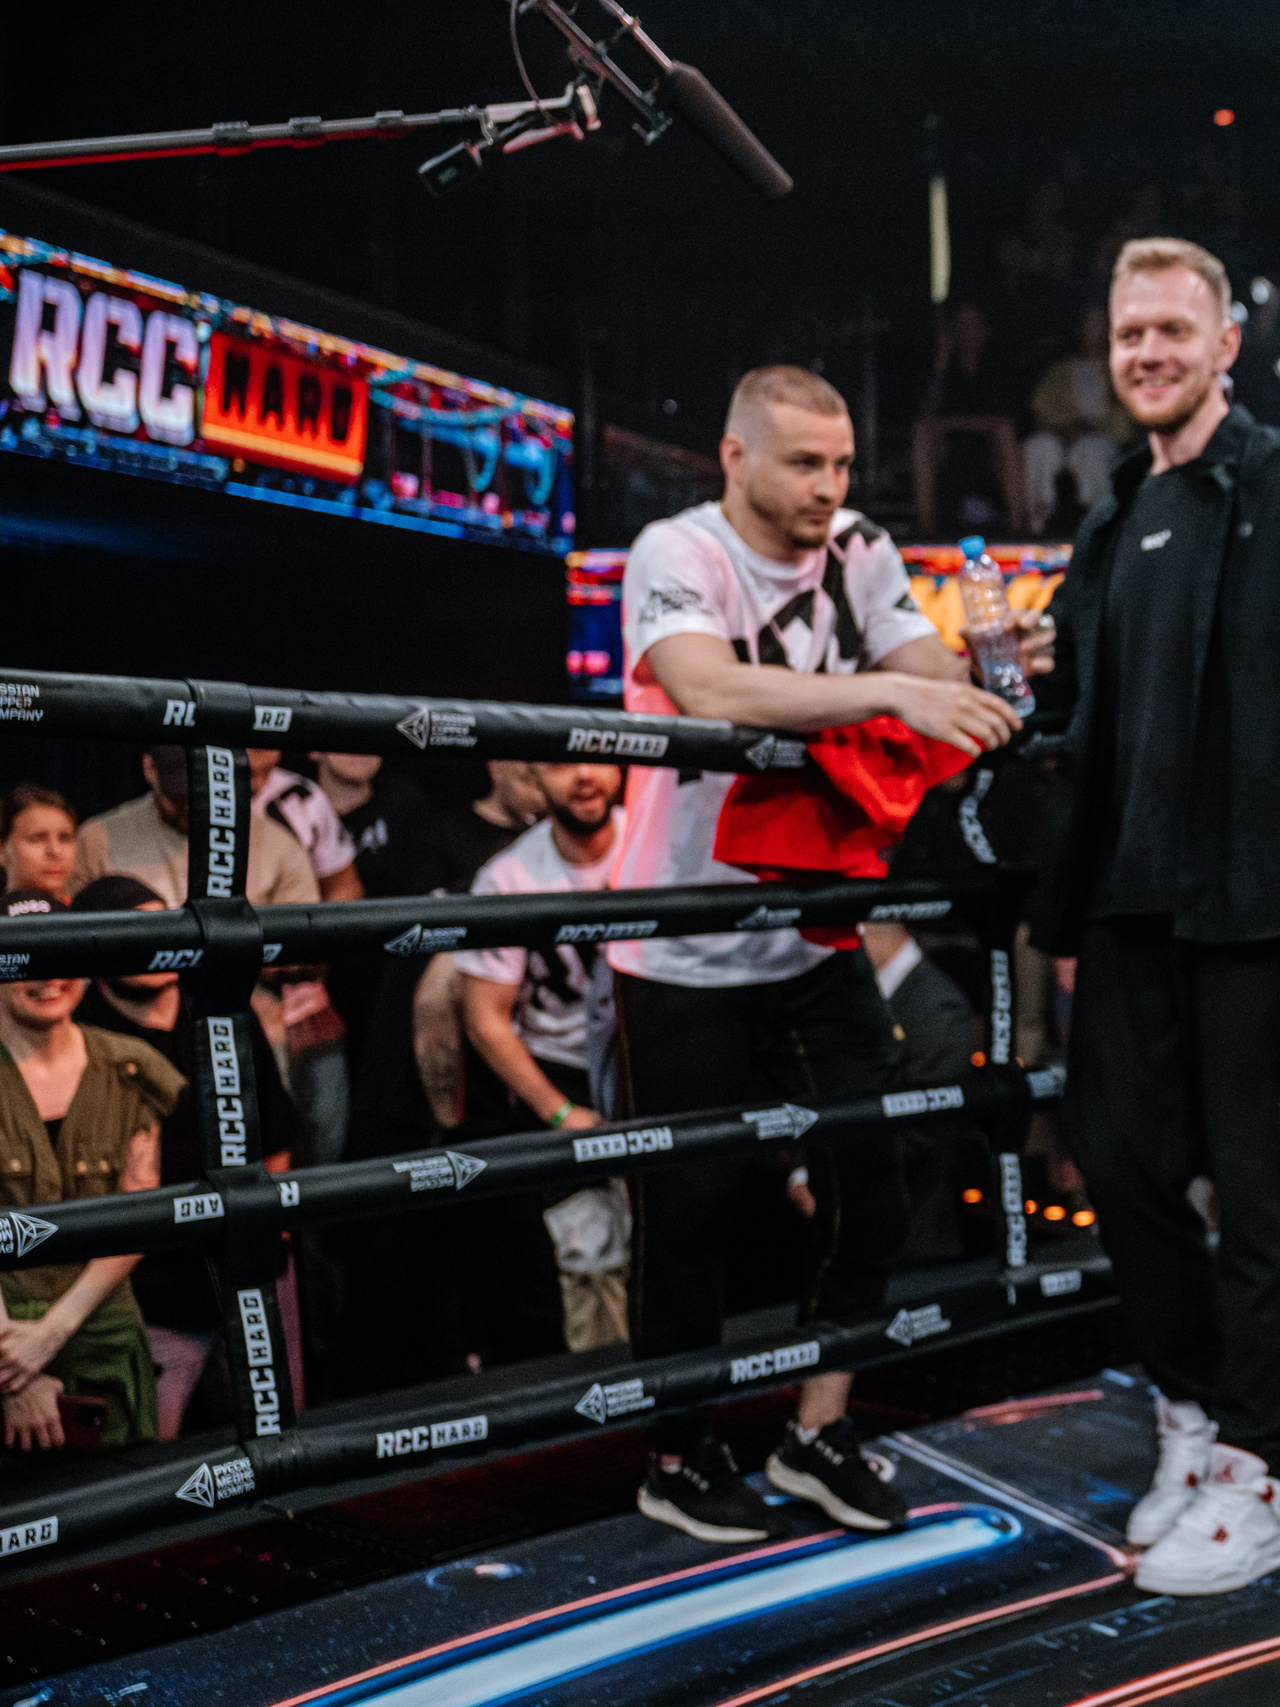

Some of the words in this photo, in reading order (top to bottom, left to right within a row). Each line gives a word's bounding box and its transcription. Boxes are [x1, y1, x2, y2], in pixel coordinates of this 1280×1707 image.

[9, 268, 198, 447] RCC
[567, 727, 617, 754] RCC
[209, 749, 234, 823] HARD
[206, 828, 235, 898] RCC
[211, 1020, 238, 1092] HARD
[217, 1097, 246, 1166] RCC
[240, 1292, 271, 1364] HARD
[249, 1367, 281, 1436] RCC
[376, 1426, 430, 1459] RCC
[0, 1519, 55, 1554] ARD
